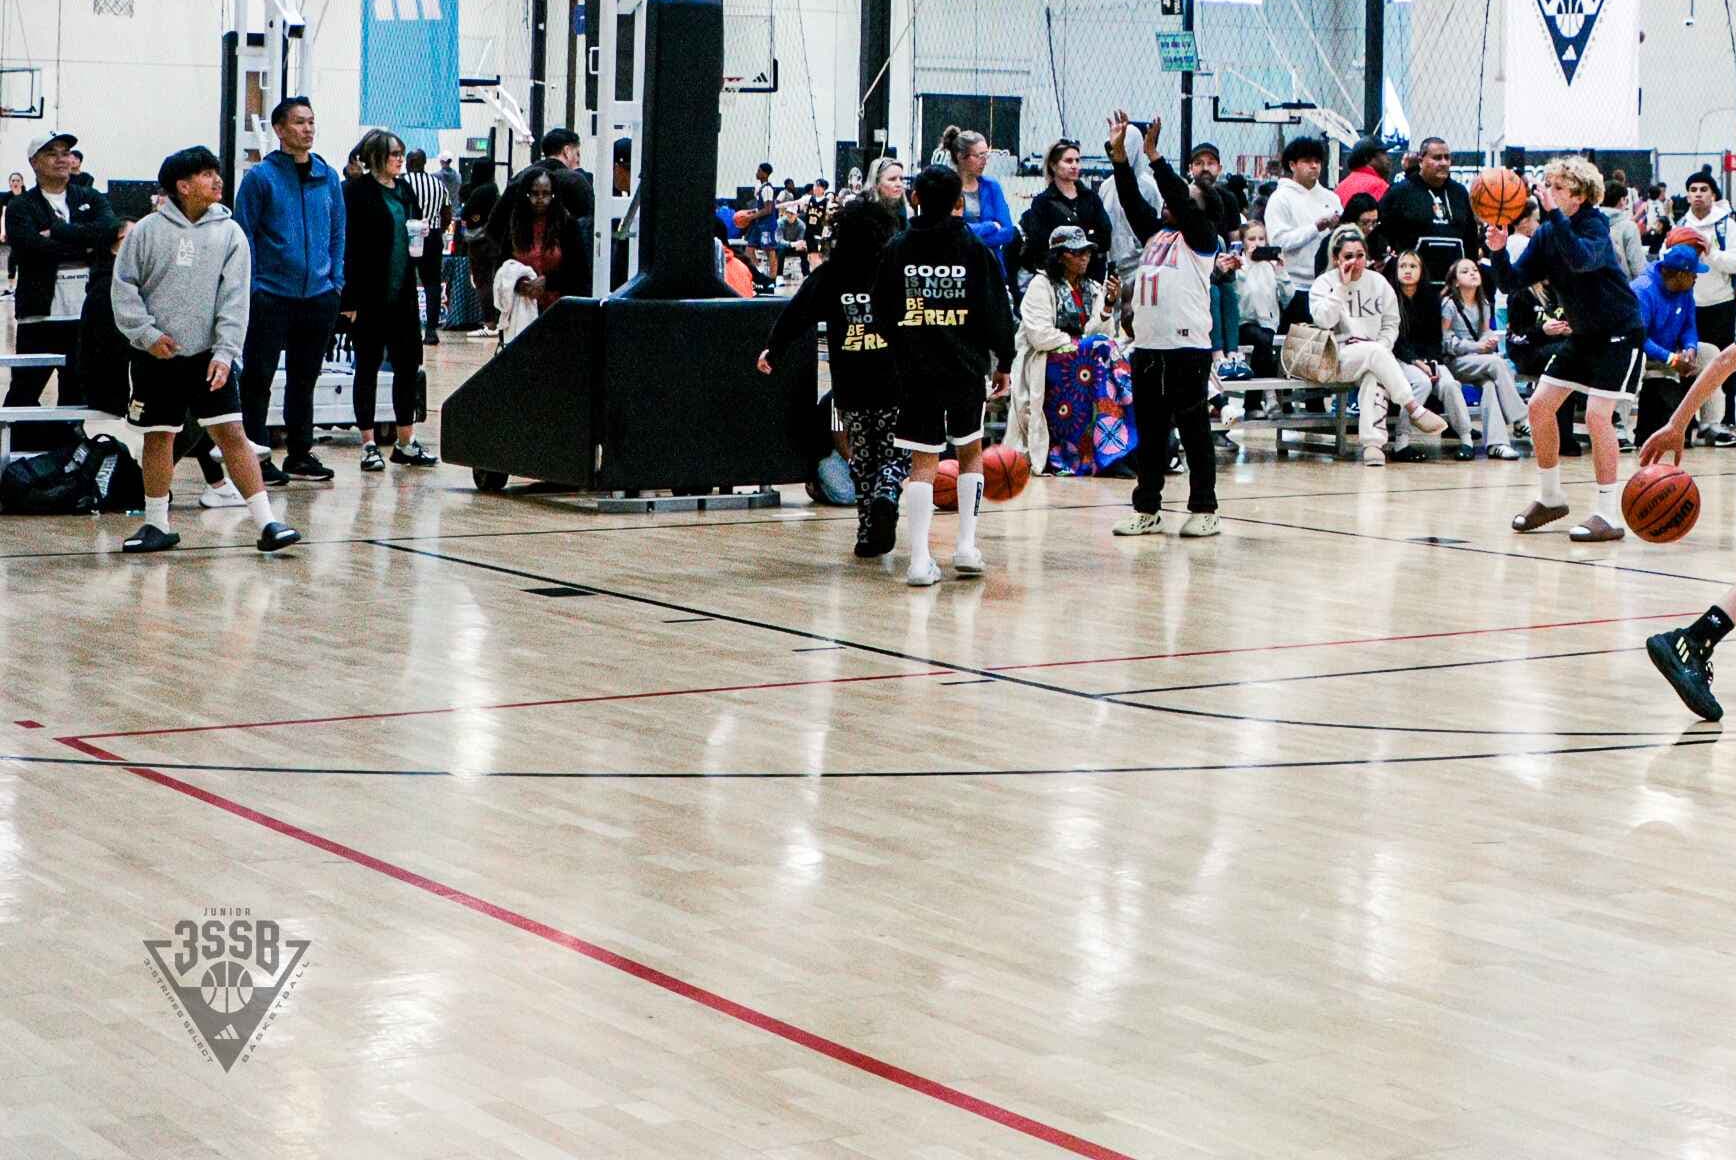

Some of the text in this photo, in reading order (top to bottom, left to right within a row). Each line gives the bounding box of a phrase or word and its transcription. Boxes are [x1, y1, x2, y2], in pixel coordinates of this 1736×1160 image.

[904, 264, 966, 278] GOOD
[904, 277, 966, 289] IS NOT
[1141, 272, 1160, 307] 11
[905, 287, 966, 299] ENOUGH
[906, 297, 925, 311] BE
[897, 308, 969, 327] GREAT
[847, 323, 865, 337] BE
